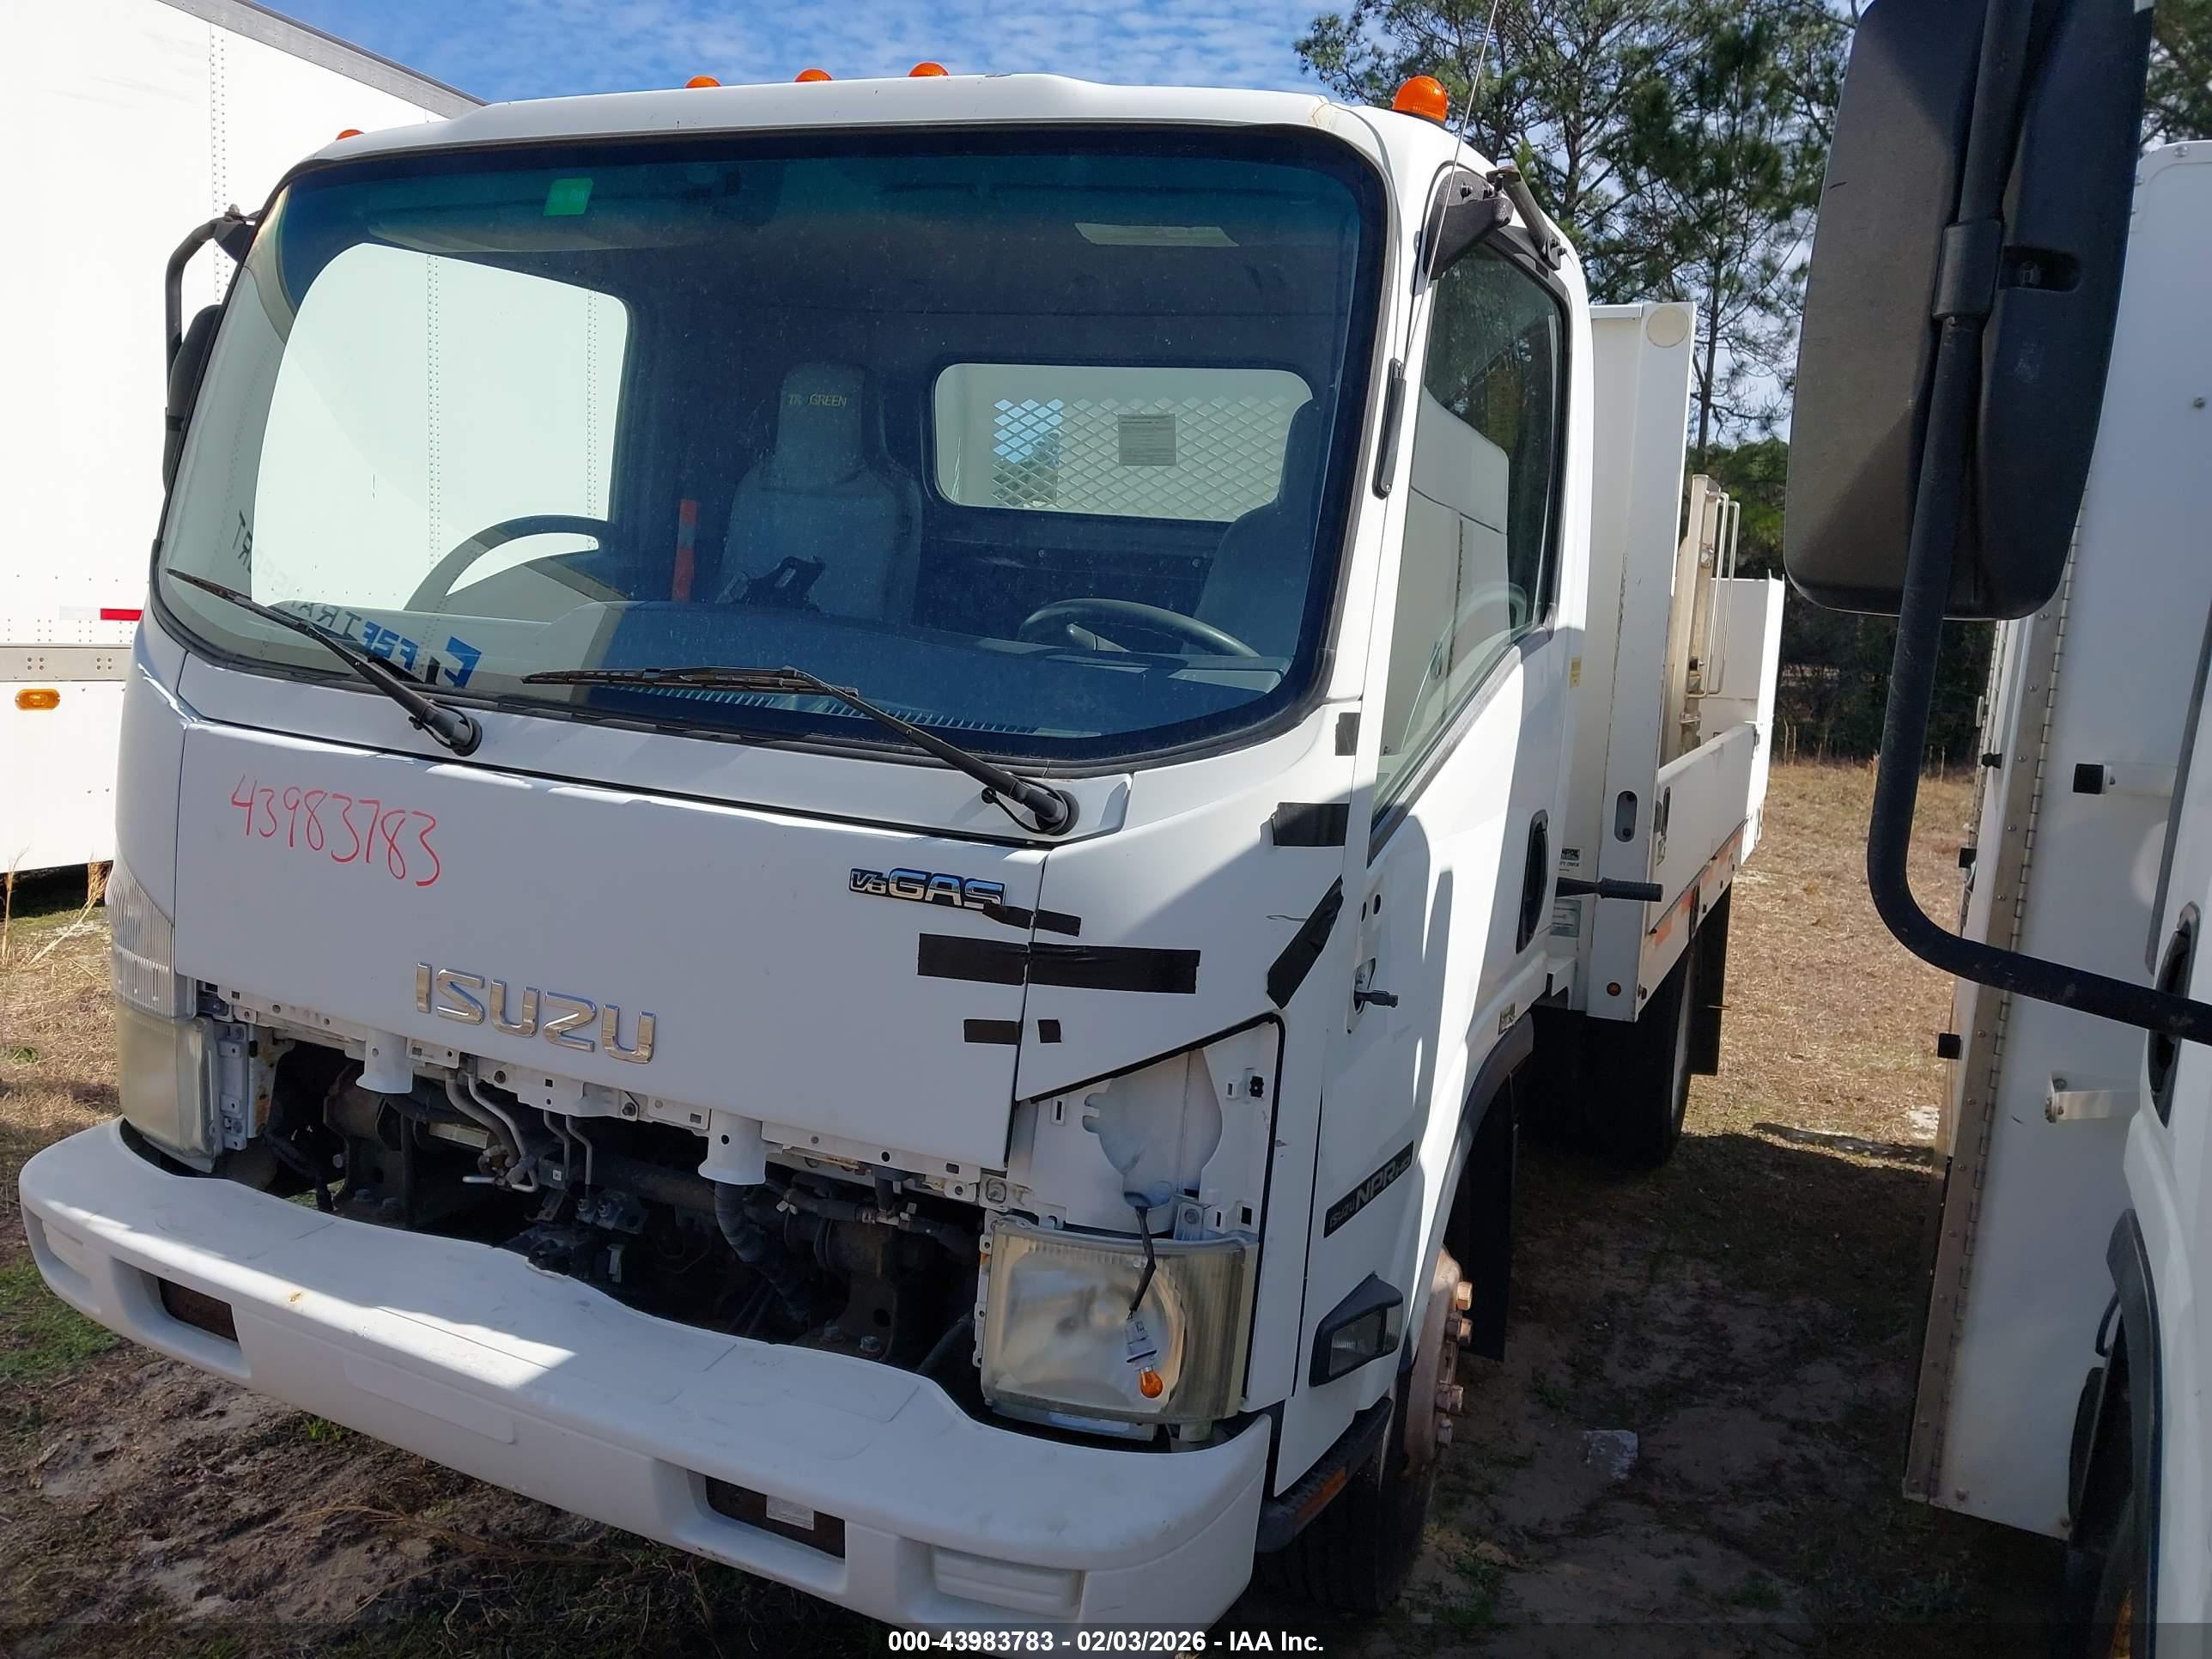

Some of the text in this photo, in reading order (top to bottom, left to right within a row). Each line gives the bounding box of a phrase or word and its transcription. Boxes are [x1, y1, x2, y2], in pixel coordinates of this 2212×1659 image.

[231, 774, 441, 887] 43983783
[888, 868, 1005, 910] GAS
[416, 961, 657, 1065] ISUZU
[1355, 1159, 1397, 1210] NPR
